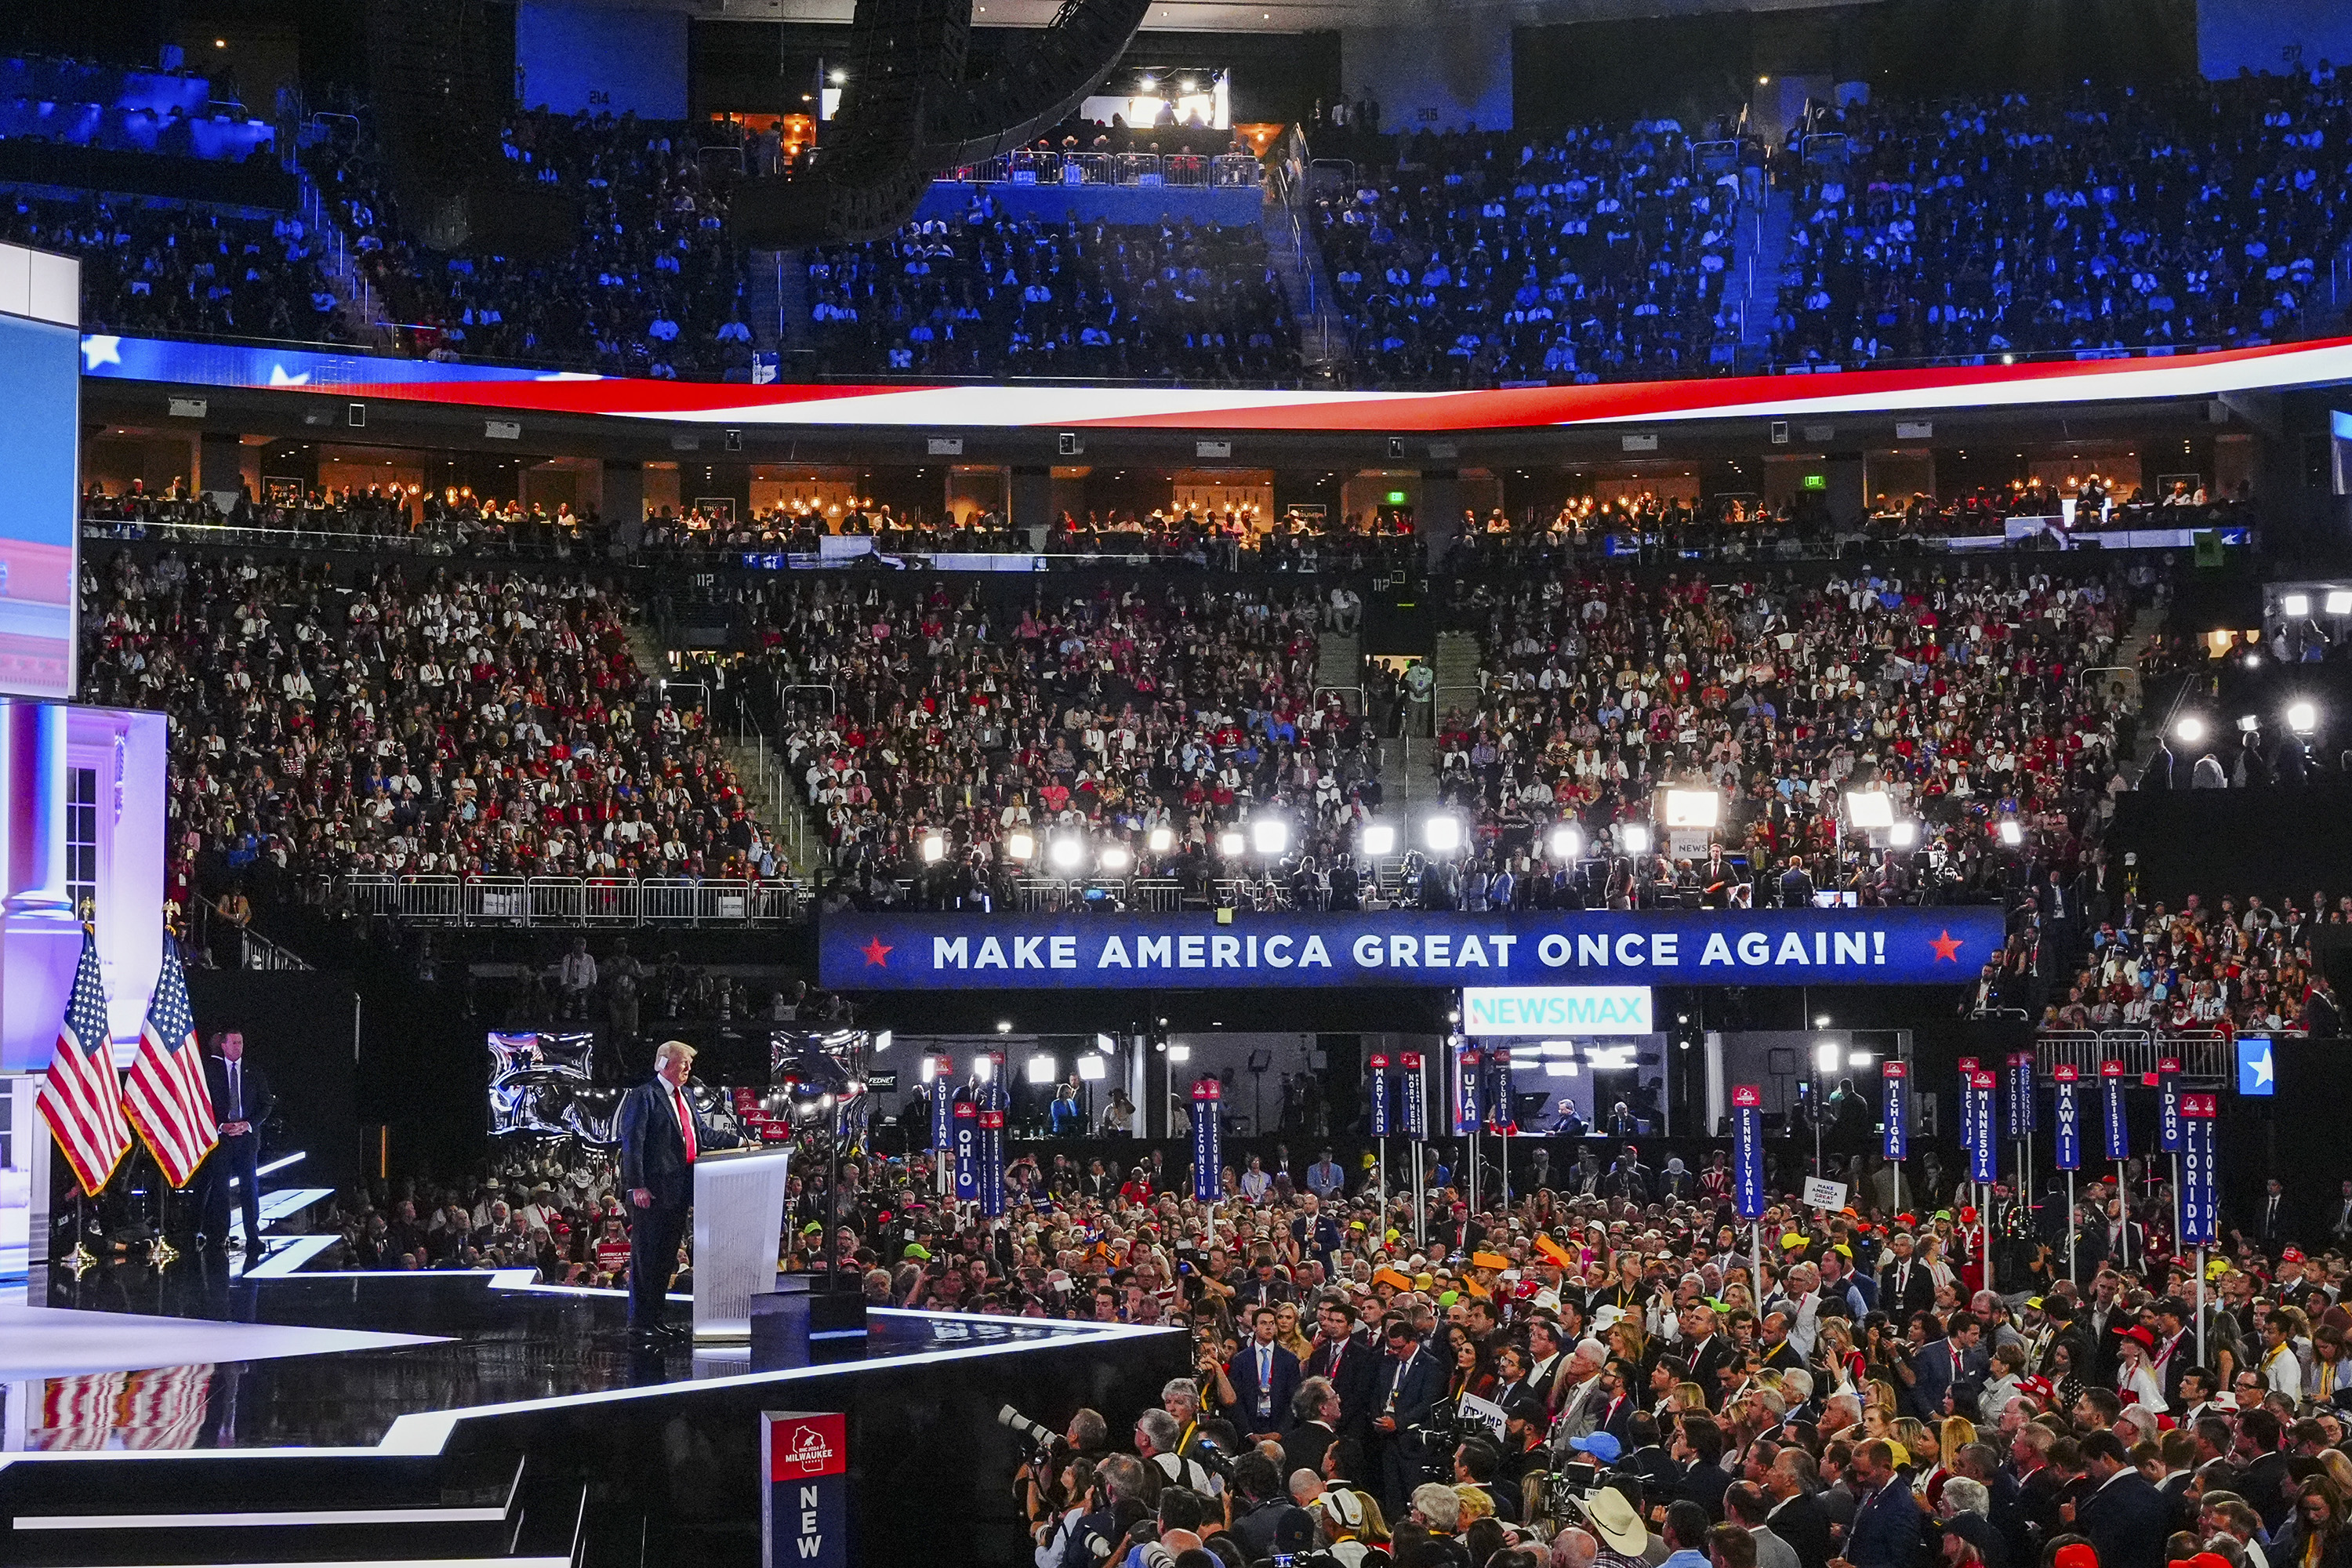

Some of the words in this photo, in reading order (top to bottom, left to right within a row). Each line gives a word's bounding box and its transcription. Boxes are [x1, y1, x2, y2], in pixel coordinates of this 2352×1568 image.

[933, 937, 1076, 968] MAKE
[1098, 935, 1332, 967] AMERICA
[1352, 935, 1517, 967] GREAT
[1537, 933, 1679, 967] ONCE
[1700, 931, 1886, 965] AGAIN!
[1472, 996, 1642, 1024] NEWSMAX
[938, 1077, 947, 1147] LOUISIANA
[1375, 1069, 1384, 1132] MARYLAND
[1464, 1074, 1475, 1121] UTAH
[1889, 1080, 1900, 1154] MICHIGAN
[2058, 1084, 2074, 1162] HAWAII
[2109, 1078, 2120, 1155] MISSISSIPPI
[2165, 1082, 2177, 1140] IDAHO
[958, 1130, 972, 1186] OHIO
[1196, 1102, 1206, 1196] WISCONSIN
[1743, 1109, 1754, 1213] PENNSYLVANIA
[1978, 1091, 1988, 1178] MINNESOTA
[1812, 1188, 1838, 1196] AMERICA
[2187, 1122, 2197, 1236] FLORIDA
[786, 1450, 833, 1463] MILWAUKEE
[797, 1486, 822, 1559] NEW
